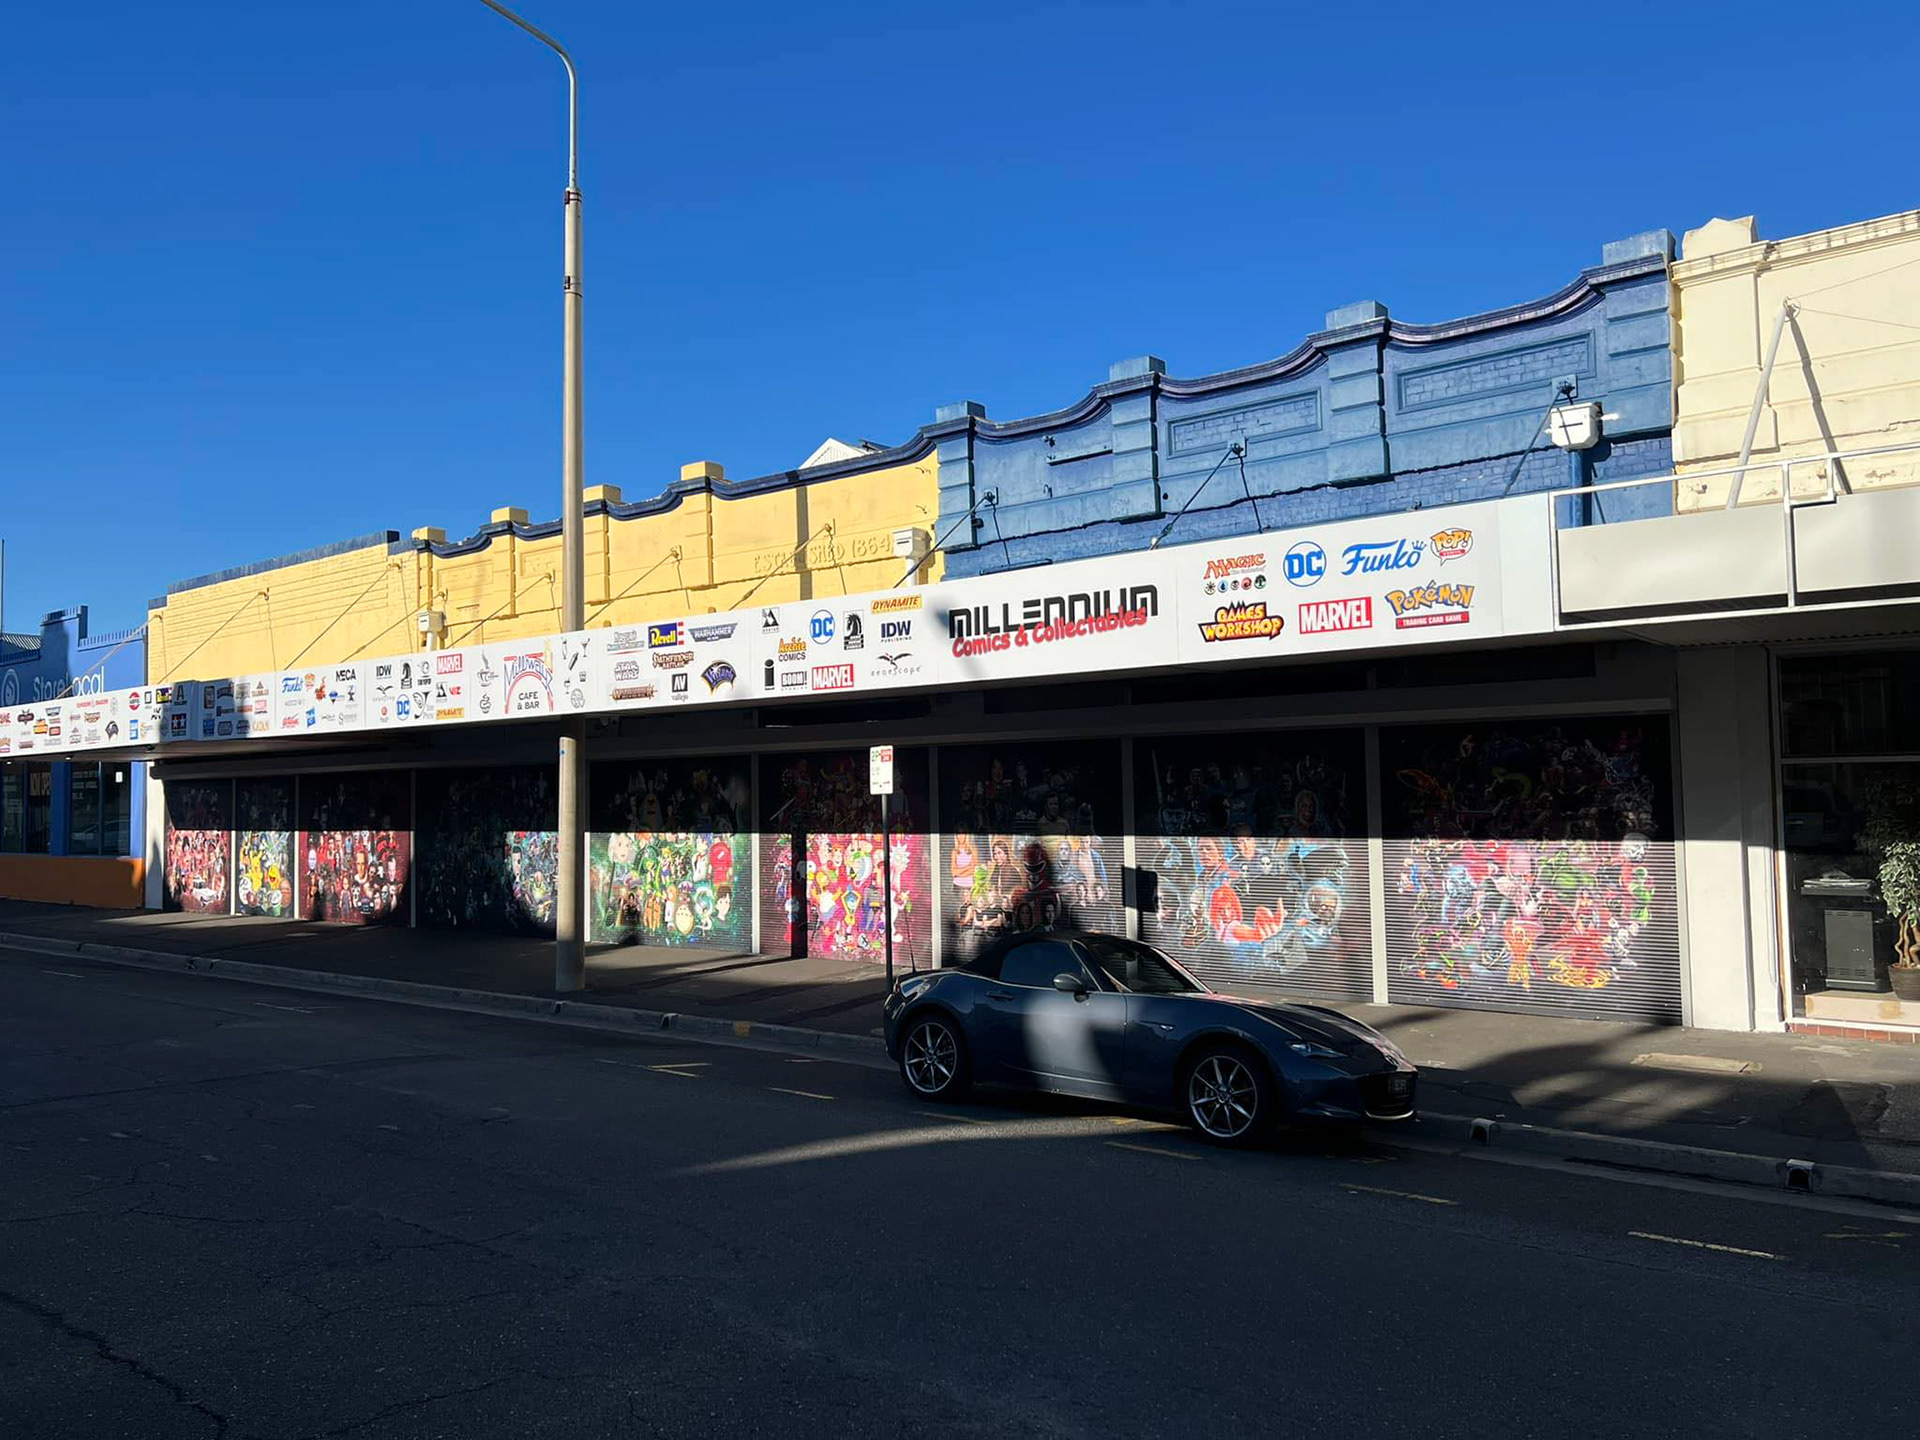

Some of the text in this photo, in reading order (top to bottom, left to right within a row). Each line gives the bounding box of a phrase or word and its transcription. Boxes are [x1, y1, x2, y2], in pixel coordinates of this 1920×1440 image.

[1203, 553, 1266, 579] MAGIC
[1285, 550, 1324, 578] DC
[1341, 538, 1421, 575] Funko
[873, 597, 918, 610] DYNAMITE
[950, 585, 1158, 638] MILLENNIUM
[1216, 601, 1265, 622] GAMES
[1301, 598, 1369, 632] MARVEL
[811, 617, 834, 638] DC
[881, 620, 911, 638] IDW
[952, 605, 1147, 657] Comics & Collectables
[1200, 617, 1283, 641] WORKSHOP
[778, 637, 806, 653] Archie
[437, 655, 462, 674] MARVEL
[778, 652, 806, 662] COMICS
[376, 664, 392, 677] IDW
[813, 665, 853, 689] MARVEL
[518, 691, 538, 701] CAFE
[525, 701, 540, 709] BAR
[397, 700, 410, 716] DC
